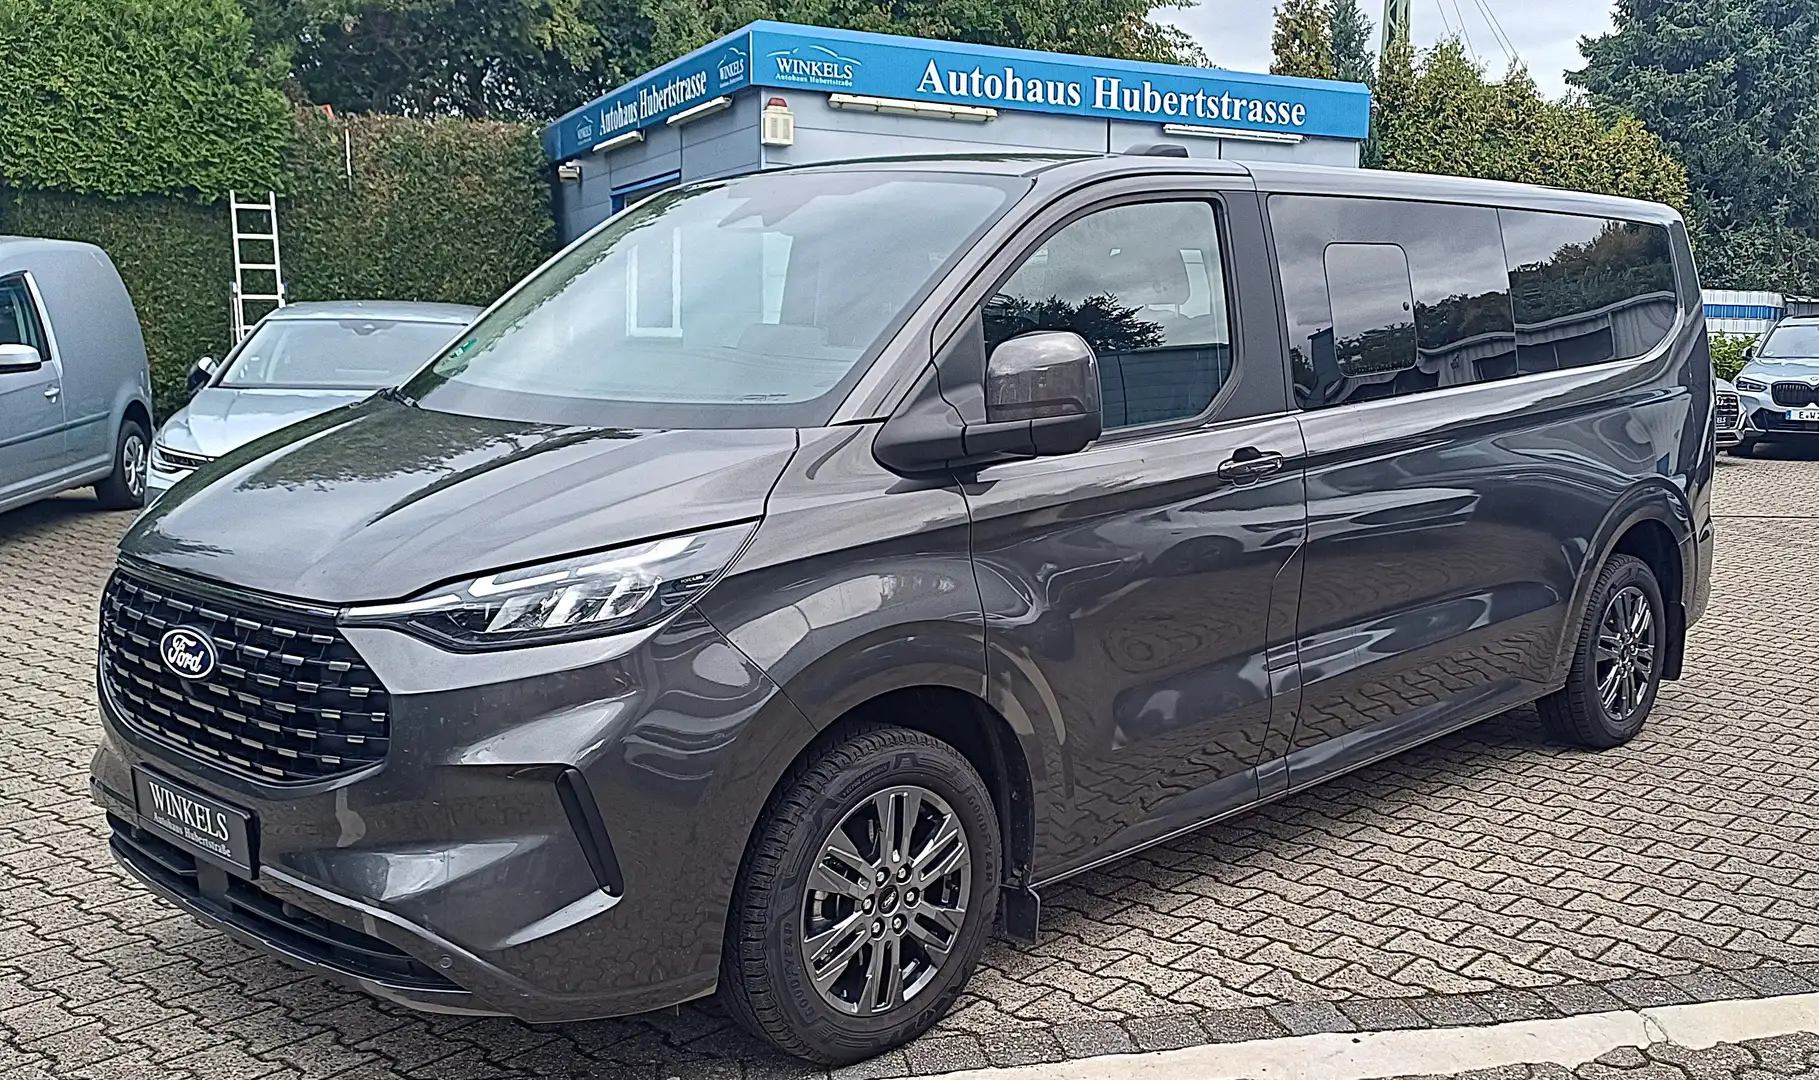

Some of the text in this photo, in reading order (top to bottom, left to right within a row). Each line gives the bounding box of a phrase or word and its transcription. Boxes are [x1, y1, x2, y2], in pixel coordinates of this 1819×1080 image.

[776, 57, 853, 79] WINKELS
[916, 59, 1306, 126] Autohaus Hubertstrasse
[600, 70, 707, 135] Autohaus Hubertstrasse
[167, 634, 205, 672] Ford
[148, 781, 229, 841] WINKELS
[967, 796, 993, 882] GOODYEAR
[784, 922, 815, 1017] GOODYEAR
